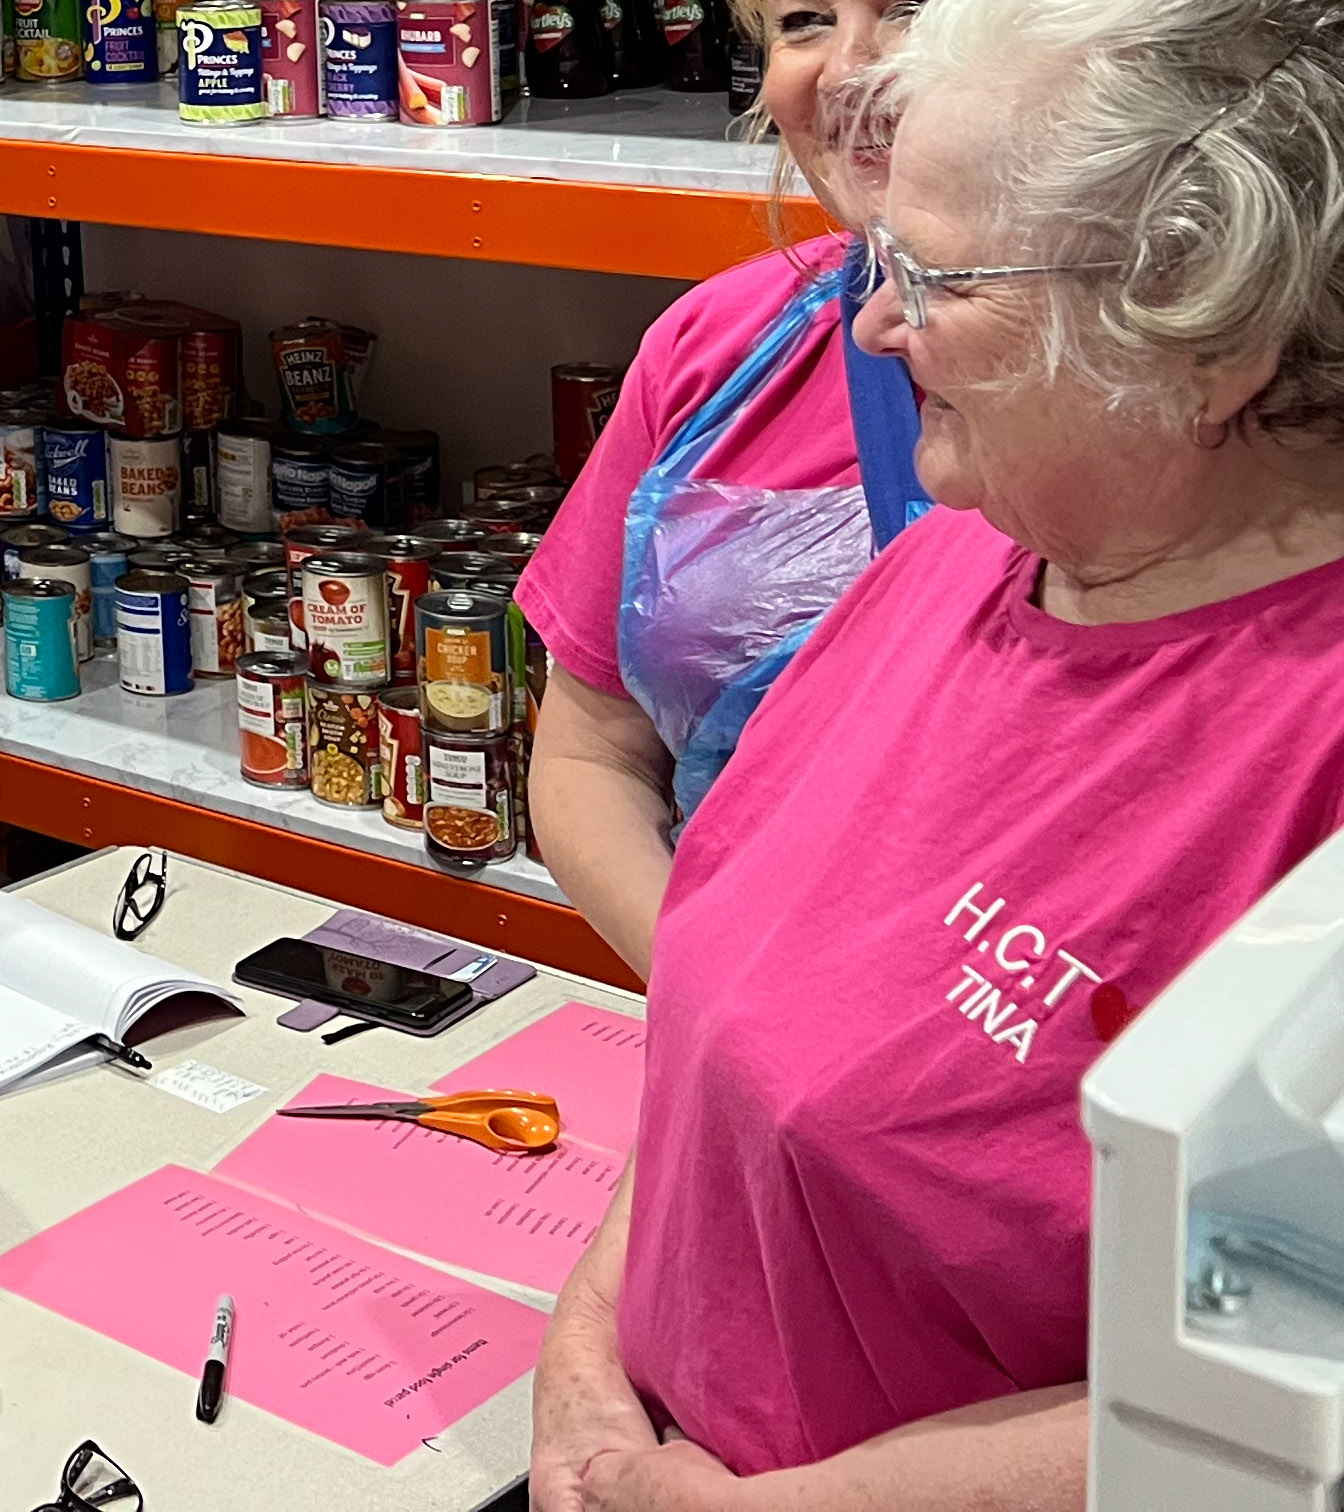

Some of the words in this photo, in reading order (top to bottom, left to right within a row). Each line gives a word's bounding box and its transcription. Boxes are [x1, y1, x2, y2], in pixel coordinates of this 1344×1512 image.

[15, 18, 38, 29] FRUIT
[103, 26, 144, 37] PRINCES
[400, 29, 441, 42] RHUBARB
[104, 40, 130, 51] FRUIT
[104, 50, 145, 62] COCKTAIL
[197, 54, 238, 65] PRINCES
[198, 78, 228, 88] APPLE
[287, 351, 323, 365] HEINZ
[284, 366, 332, 386] BEANZ
[120, 466, 163, 480] BAKED
[121, 481, 165, 496] BEANS
[308, 603, 348, 615] CREAM
[350, 603, 366, 614] OF
[312, 614, 363, 626] TOMATO
[437, 643, 477, 656] CHICKEN
[446, 655, 468, 665] SOUP
[444, 770, 467, 780] SOUP
[943, 881, 1103, 1007] H.C.T
[945, 965, 1038, 1064] TINA
[450, 1354, 468, 1364] for
[427, 1361, 453, 1378] single
[408, 1377, 433, 1393] food
